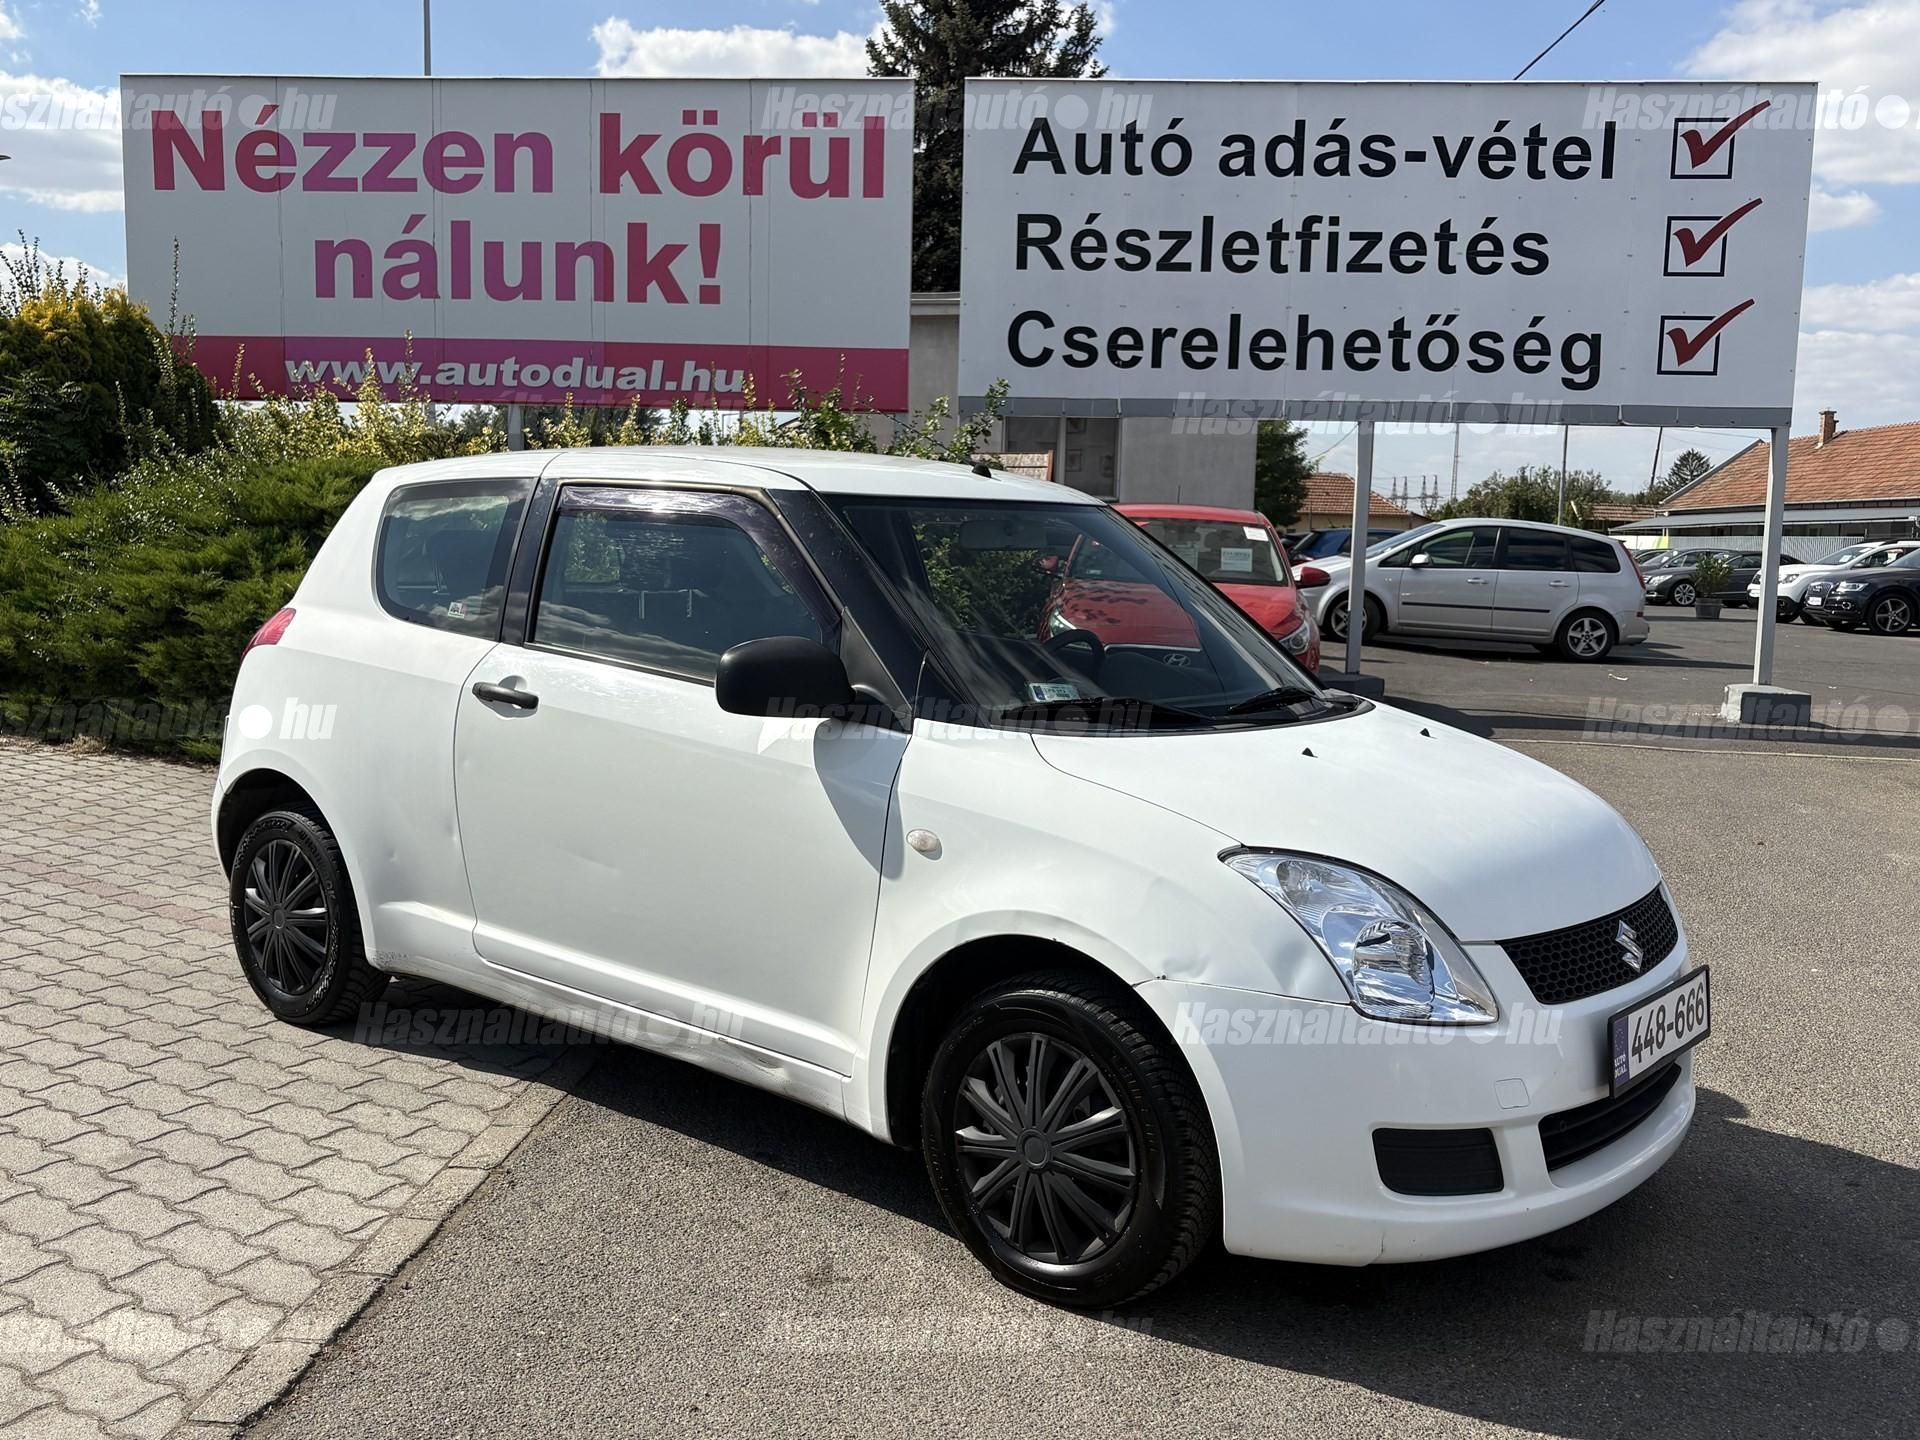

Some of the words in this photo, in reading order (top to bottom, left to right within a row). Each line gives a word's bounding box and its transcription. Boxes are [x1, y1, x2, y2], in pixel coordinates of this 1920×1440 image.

[151, 105, 555, 194] Nézzen
[599, 109, 885, 199] körül
[1012, 116, 1194, 177] Autó
[1218, 117, 1617, 180] adás-vétel
[314, 213, 722, 305] nálunk!
[1015, 211, 1550, 277] Részletfizetés
[284, 356, 746, 394] www.autodual.hu
[1007, 309, 1602, 391] Cserelehetőség
[1631, 981, 1705, 1064] 448-666
